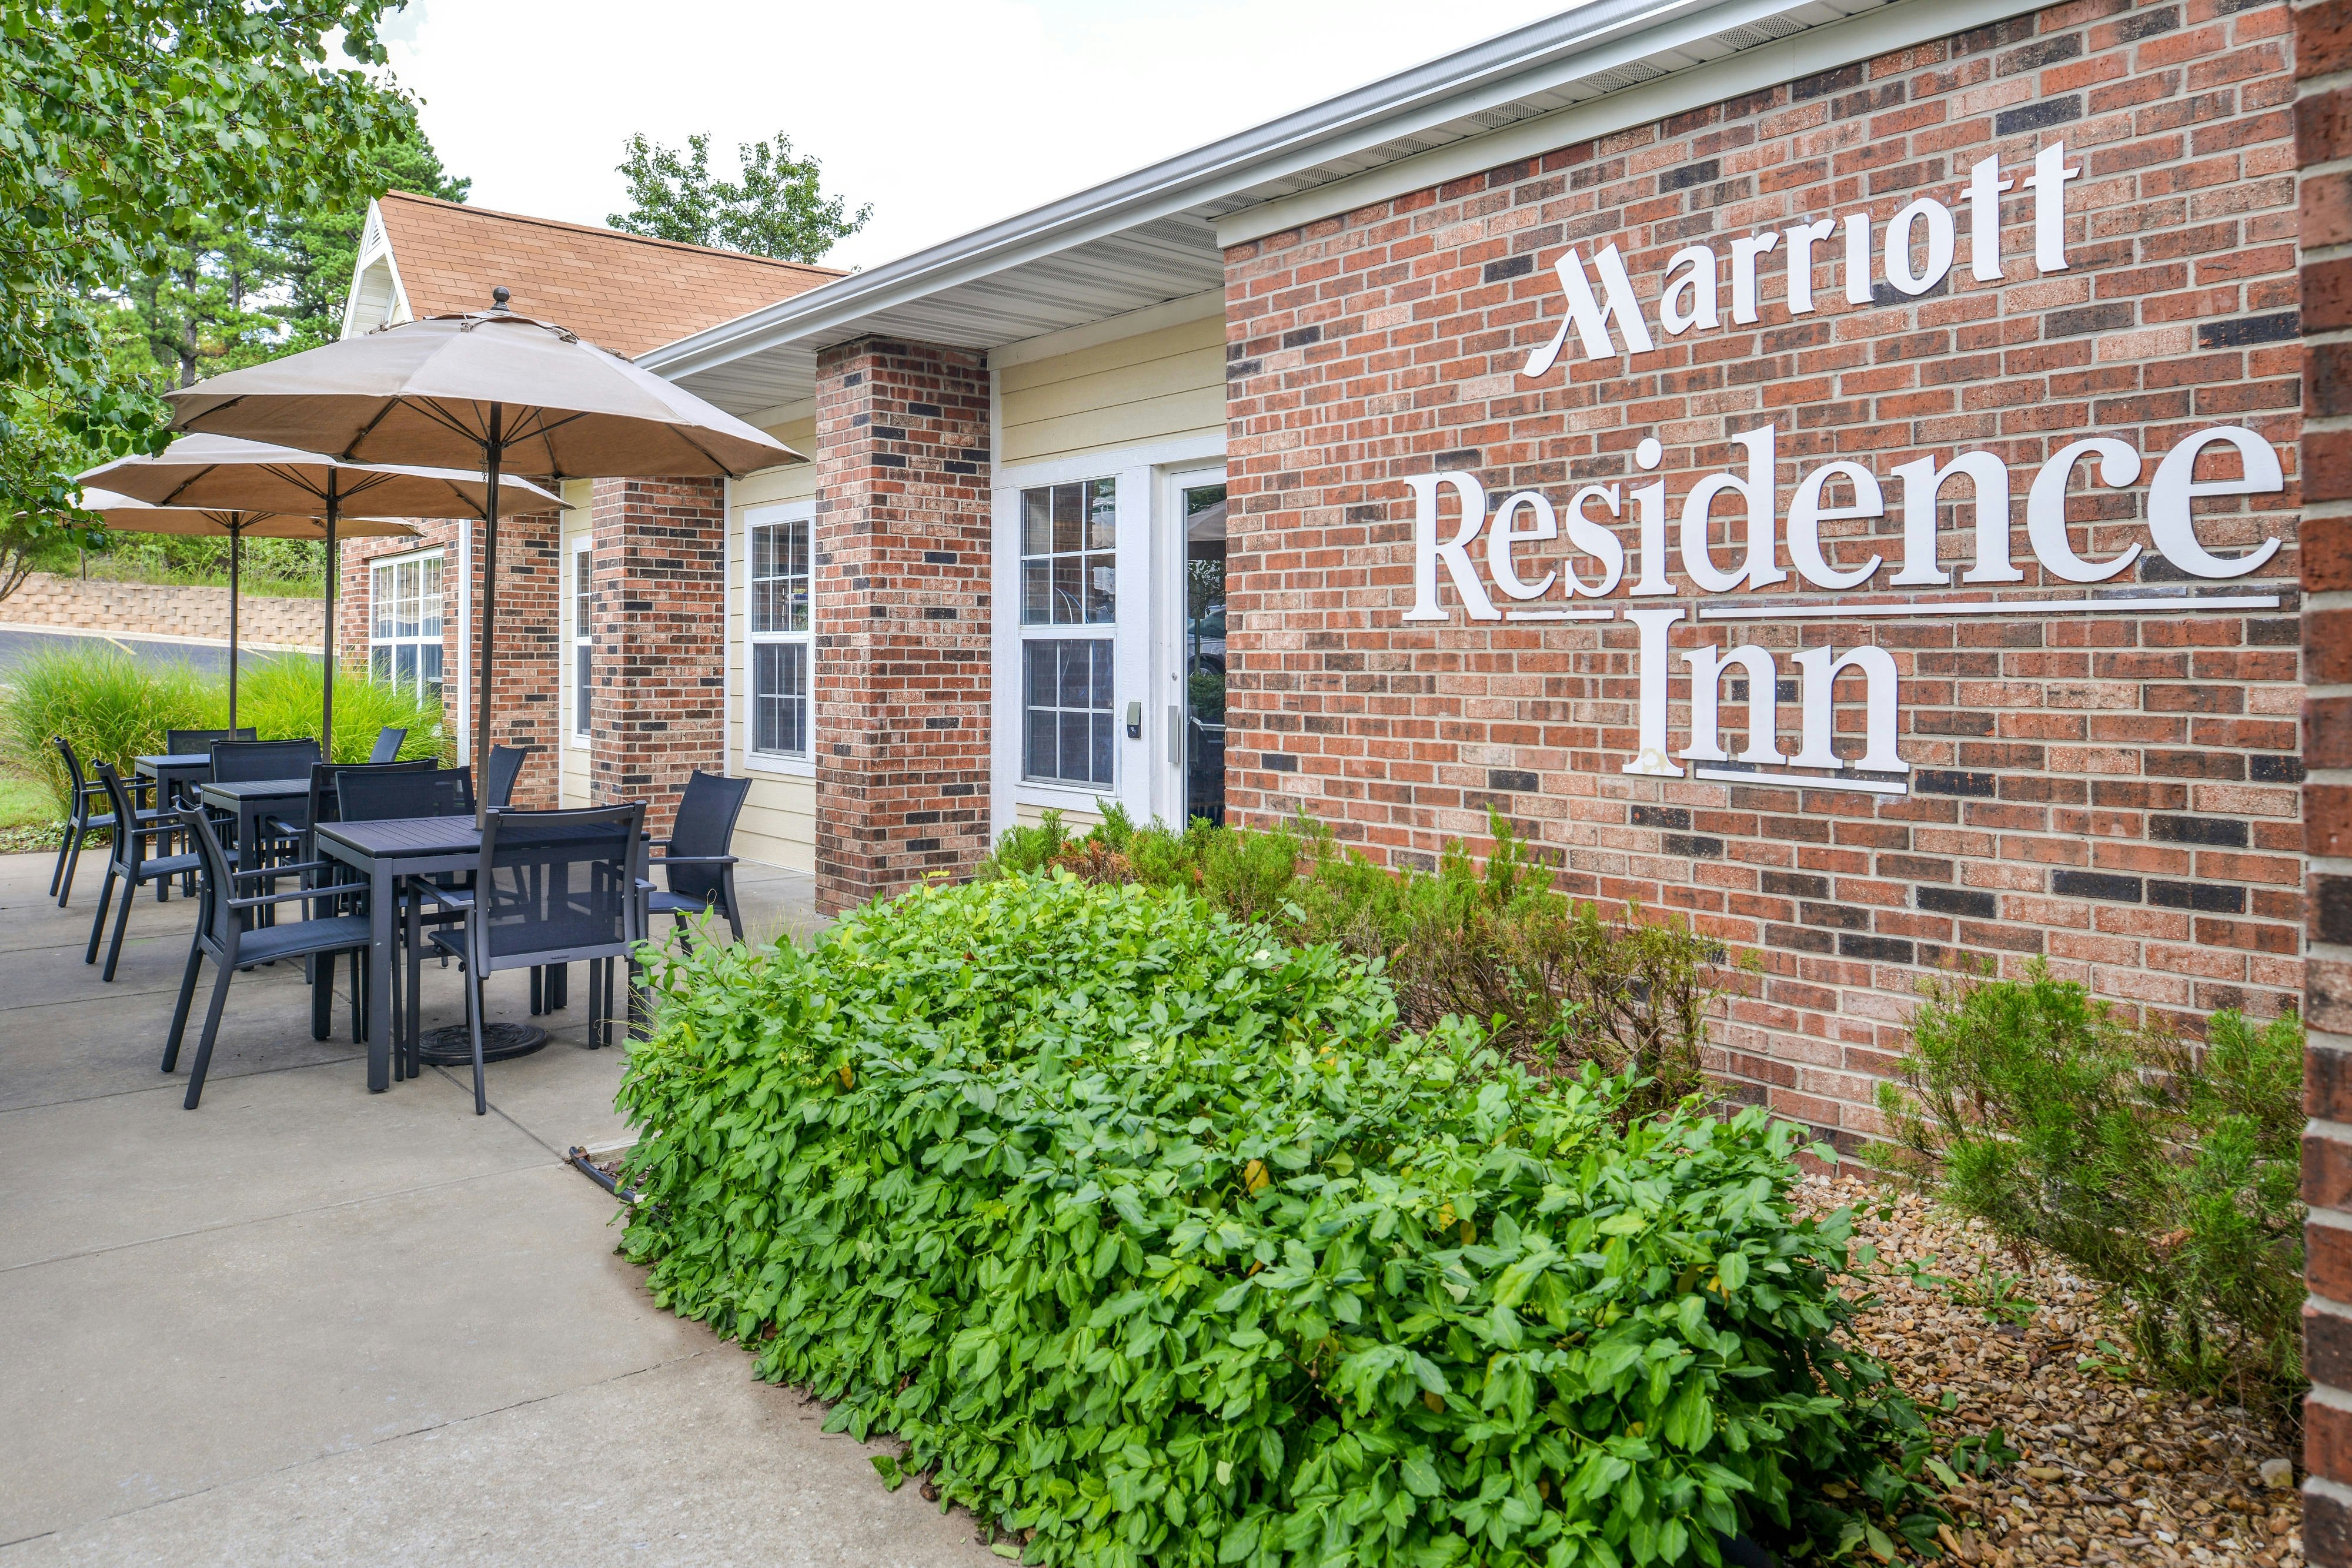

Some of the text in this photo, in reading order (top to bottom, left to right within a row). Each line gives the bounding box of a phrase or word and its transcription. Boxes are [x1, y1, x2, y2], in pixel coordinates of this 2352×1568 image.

[1522, 140, 2080, 378] Marriott
[1402, 423, 2284, 621] Residence
[1622, 609, 1909, 777] Inn
